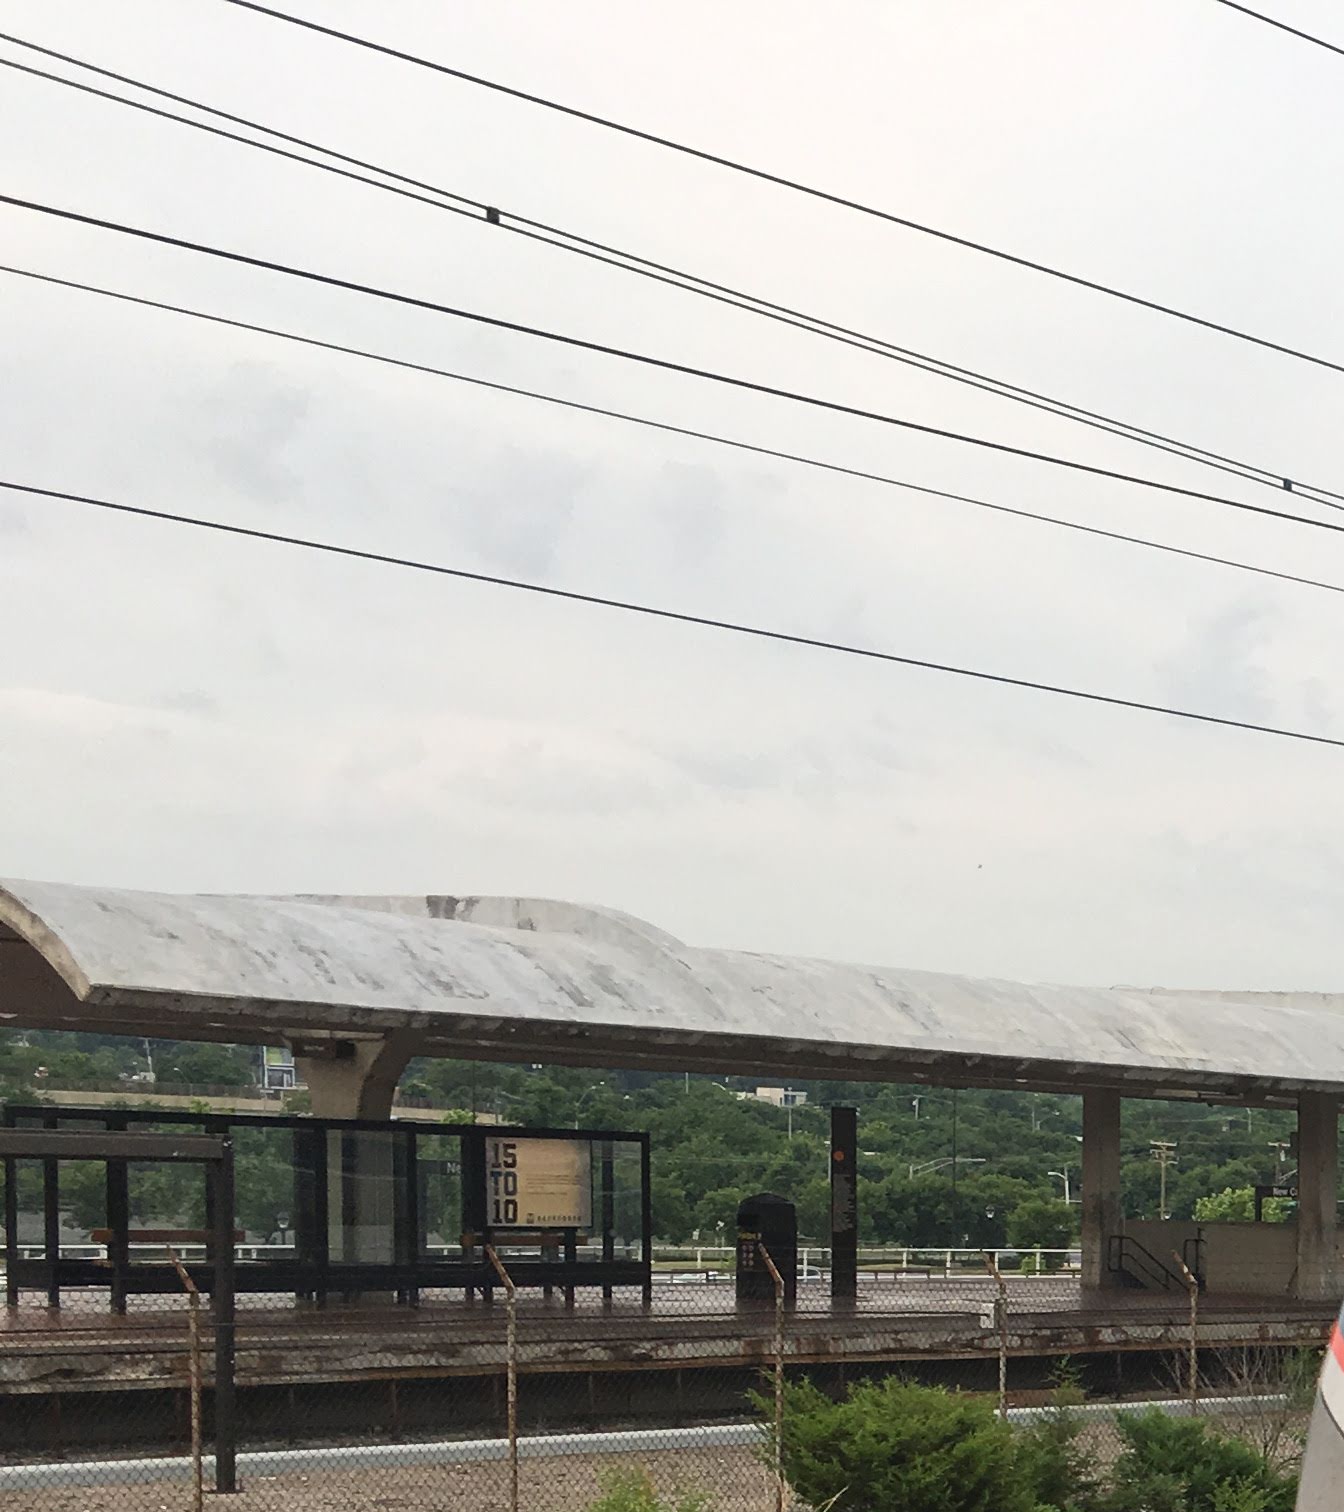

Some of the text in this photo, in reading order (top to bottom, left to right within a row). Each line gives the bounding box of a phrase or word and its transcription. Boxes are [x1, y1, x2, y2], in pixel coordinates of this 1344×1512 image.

[491, 1142, 518, 1169] 15
[490, 1171, 518, 1196] TO
[492, 1198, 518, 1224] 10
